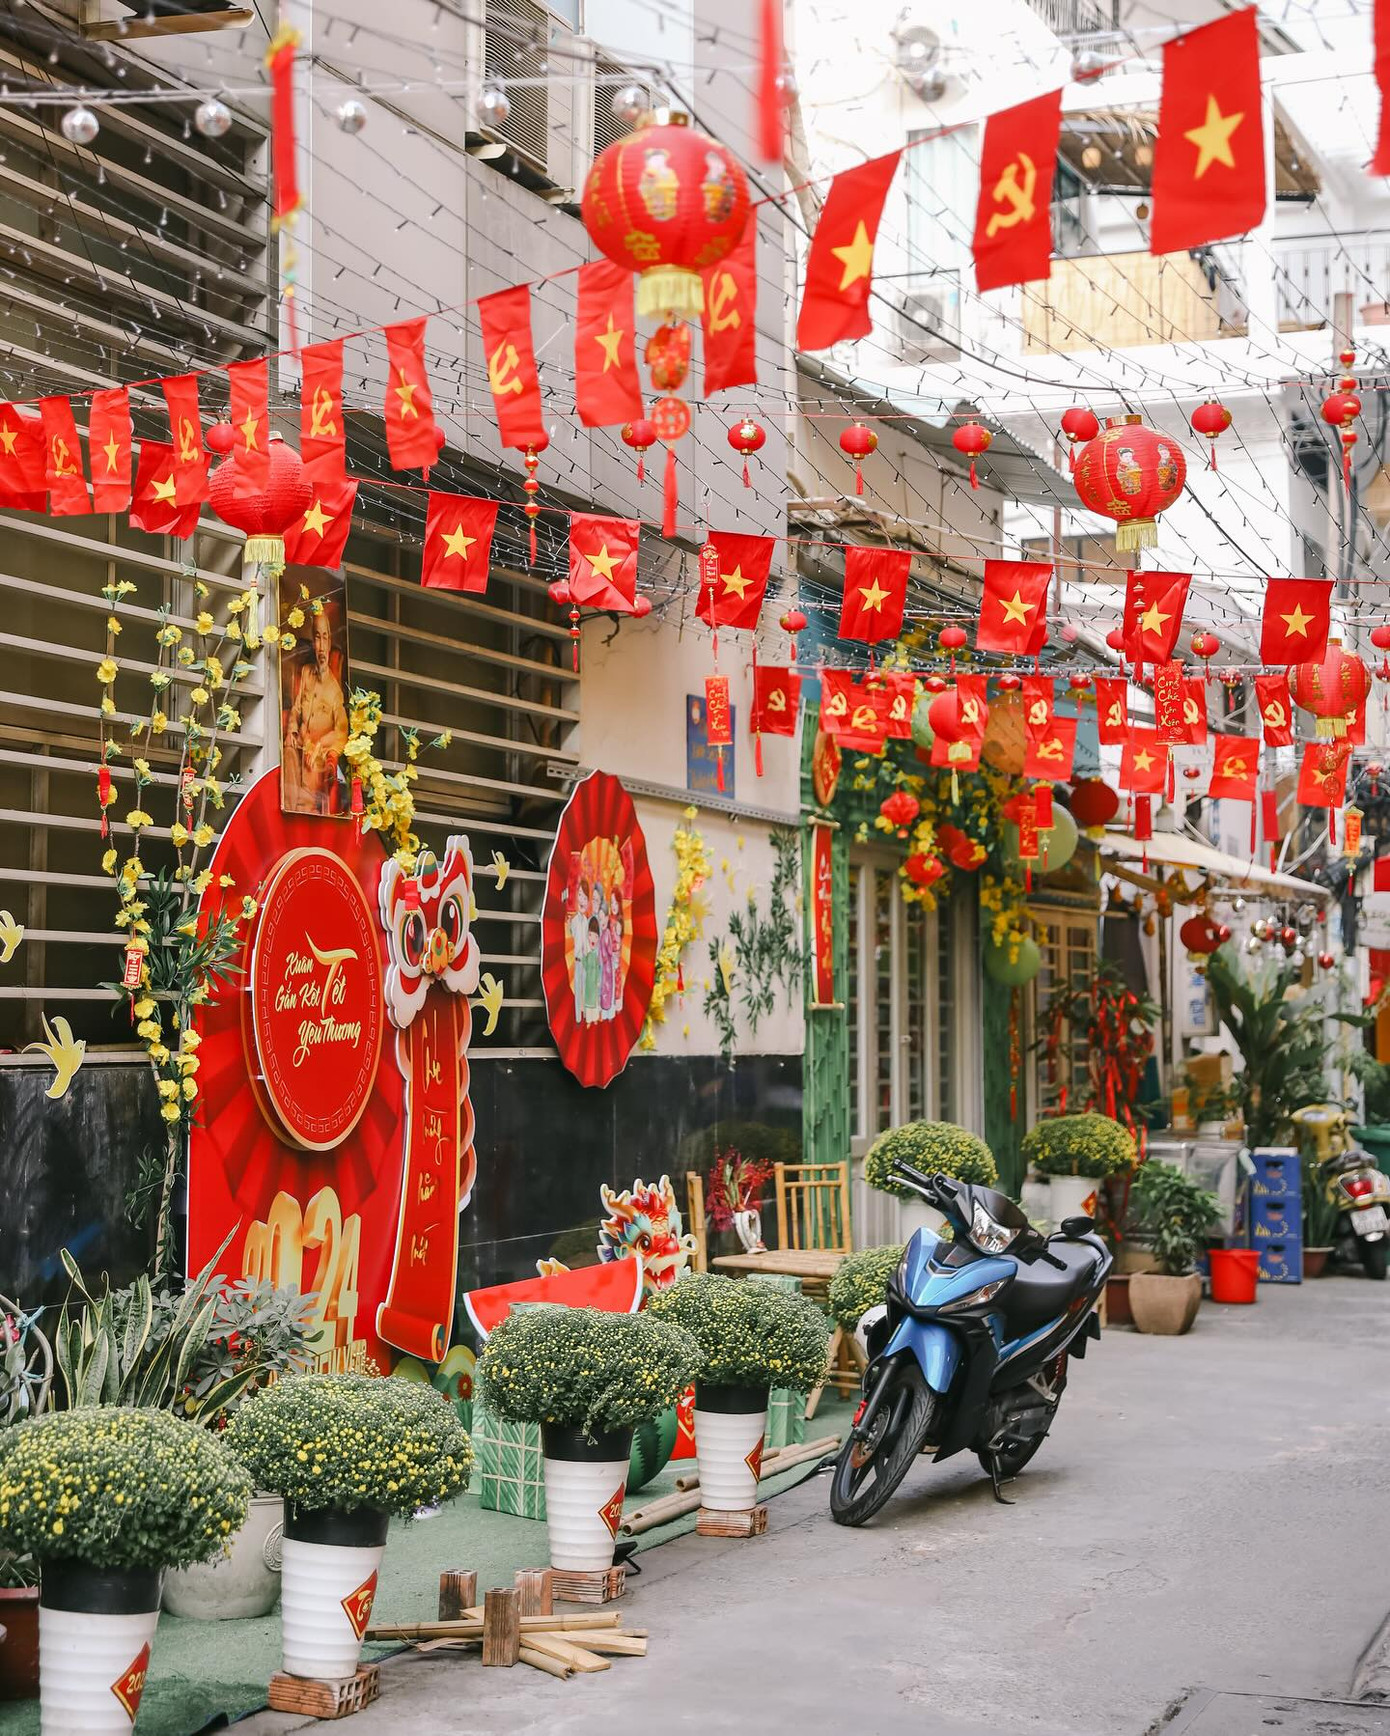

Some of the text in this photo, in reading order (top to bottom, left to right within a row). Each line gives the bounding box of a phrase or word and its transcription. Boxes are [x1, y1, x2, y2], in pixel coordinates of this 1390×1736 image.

[284, 951, 314, 981] Xuân
[305, 930, 358, 1018] Tết
[275, 980, 320, 1012] Gắn Kết
[293, 1015, 361, 1067] Yêu Thương
